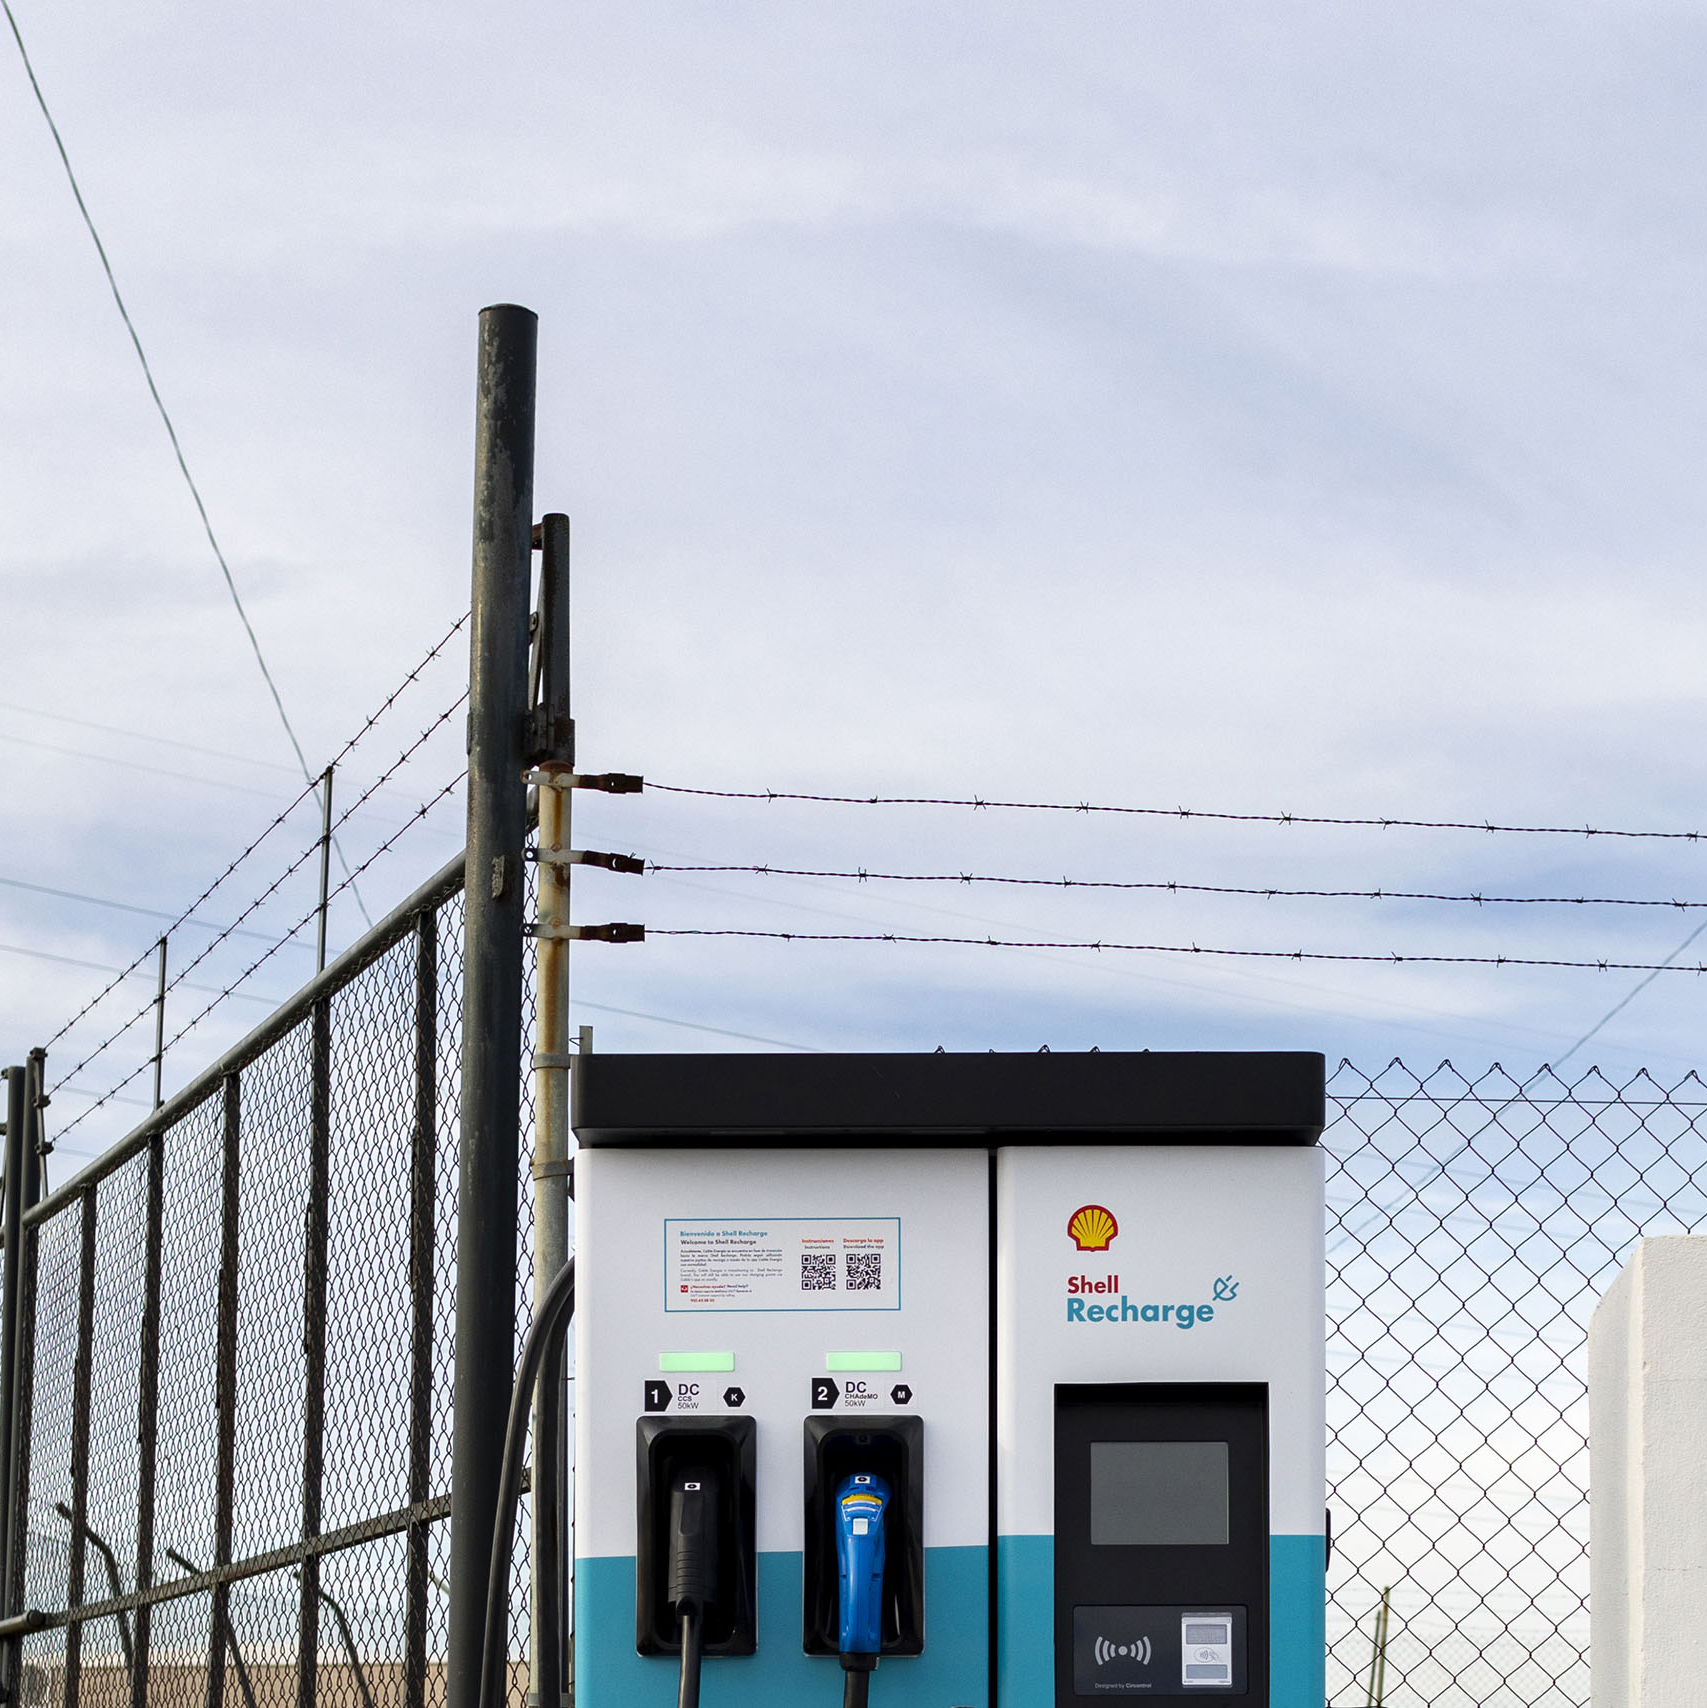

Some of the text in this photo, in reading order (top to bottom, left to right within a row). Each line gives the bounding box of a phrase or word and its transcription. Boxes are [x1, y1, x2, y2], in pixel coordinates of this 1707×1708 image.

[738, 1230, 768, 1238] Recharge
[1067, 1275, 1119, 1294] Shell
[1067, 1295, 1214, 1330] Recharge
[678, 1383, 700, 1396] DC
[845, 1381, 867, 1393] DC
[651, 1389, 658, 1404] 1
[730, 1393, 739, 1402] K
[817, 1386, 828, 1401] 2
[897, 1390, 906, 1399] M
[677, 1402, 699, 1410] 50kW
[844, 1399, 866, 1408] 50kW
[1118, 1682, 1125, 1690] by
